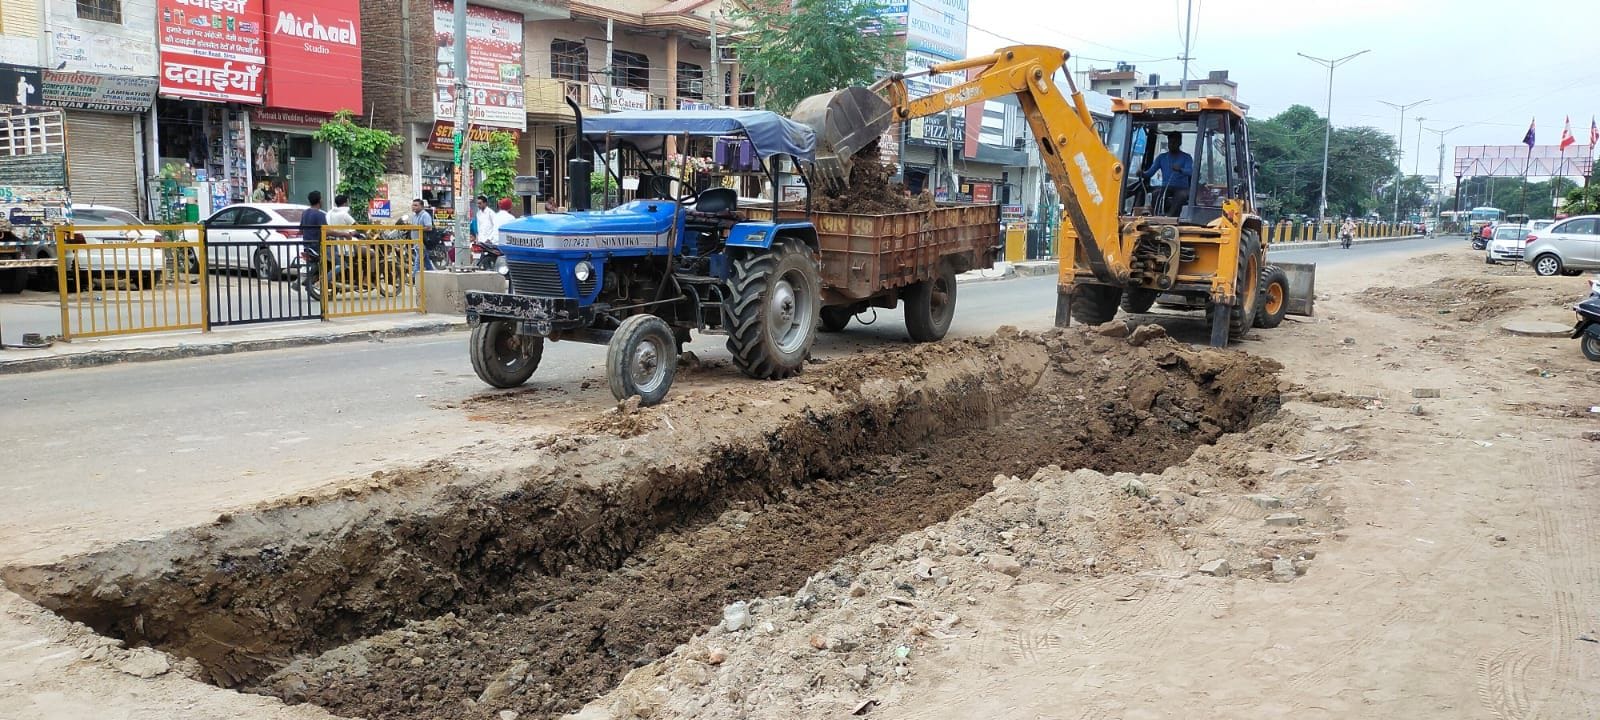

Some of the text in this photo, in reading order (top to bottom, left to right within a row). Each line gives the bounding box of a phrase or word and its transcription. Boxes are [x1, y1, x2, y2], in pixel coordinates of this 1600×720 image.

[274, 11, 356, 46] Michael
[304, 43, 329, 54] Studio
[43, 71, 103, 85] PHOTOSTAT
[42, 83, 75, 91] COMPUTER
[87, 103, 149, 112] PHOTOSTAT
[601, 237, 639, 246] SONALIKA
